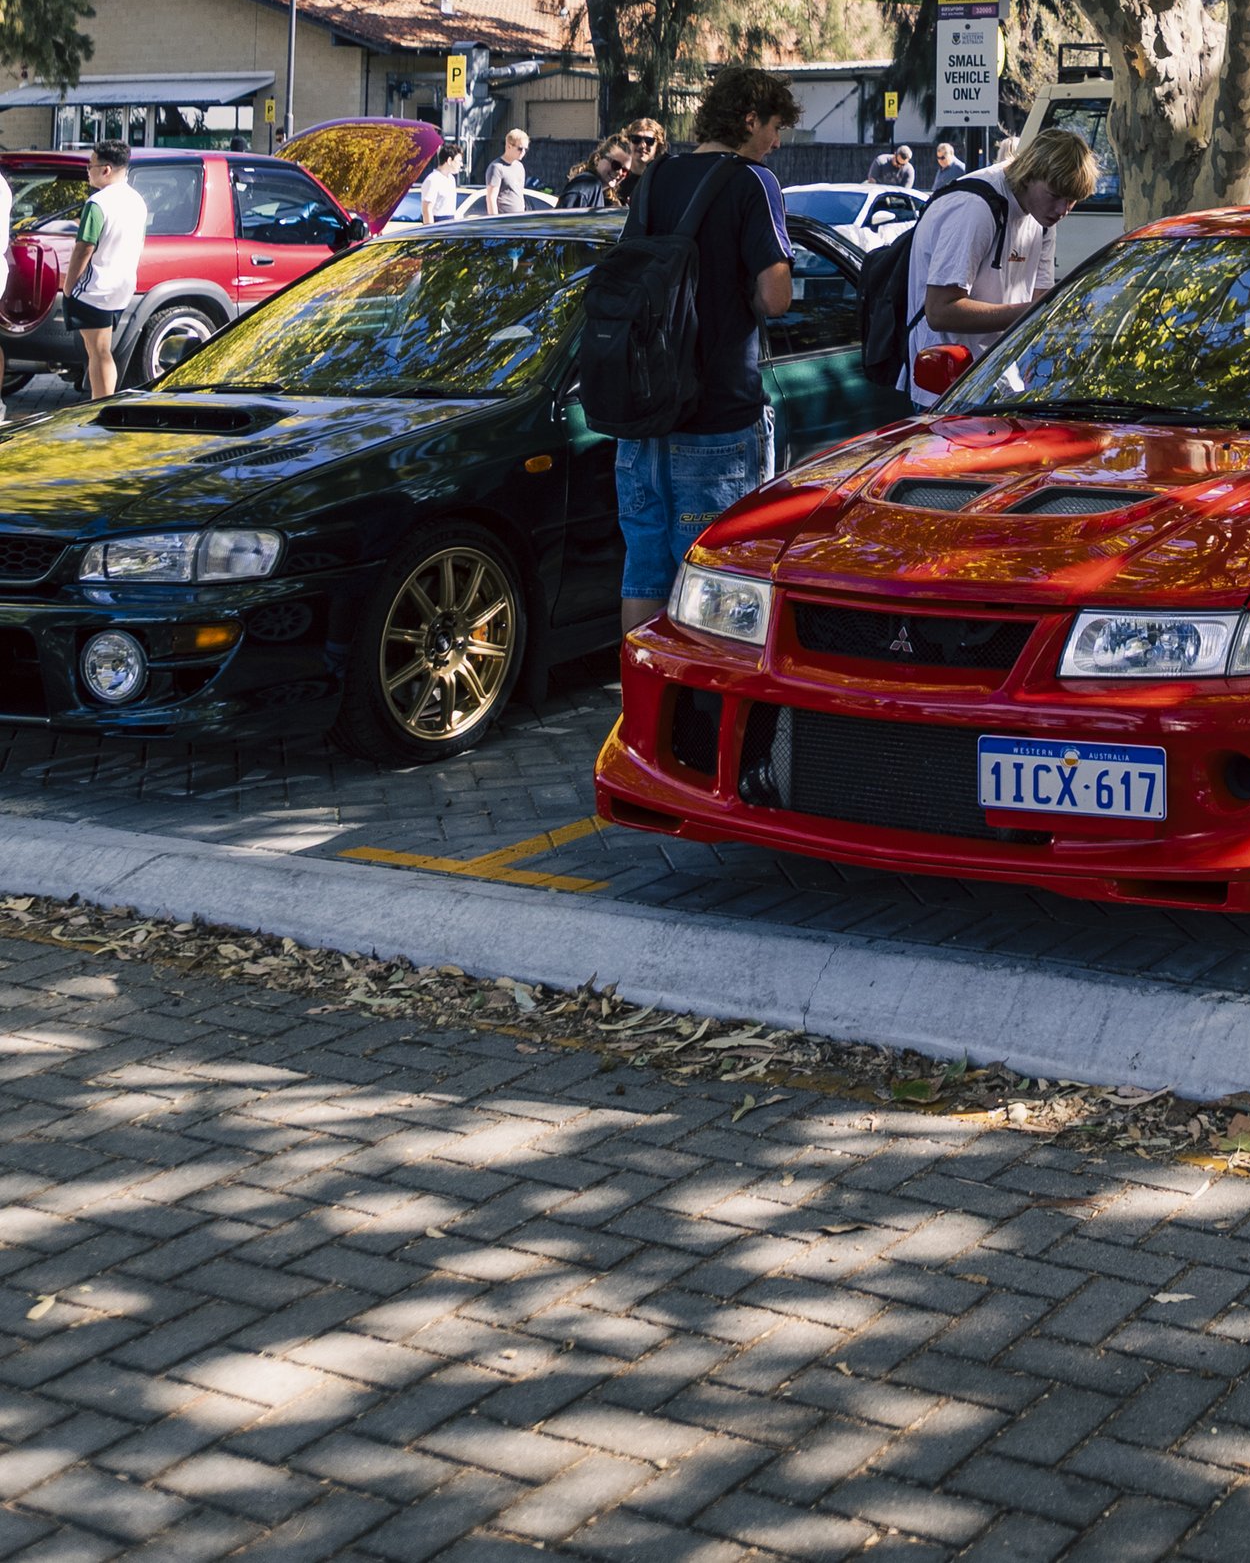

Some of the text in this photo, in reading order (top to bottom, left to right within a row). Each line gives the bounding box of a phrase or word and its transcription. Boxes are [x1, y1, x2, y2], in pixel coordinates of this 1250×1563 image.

[948, 54, 986, 67] SMALL
[452, 67, 462, 82] P
[944, 71, 990, 84] VEHICLE
[953, 88, 981, 100] ONLY
[267, 105, 274, 114] P
[888, 99, 895, 108] P
[1013, 747, 1130, 762] WESTERN AUSTRALIA
